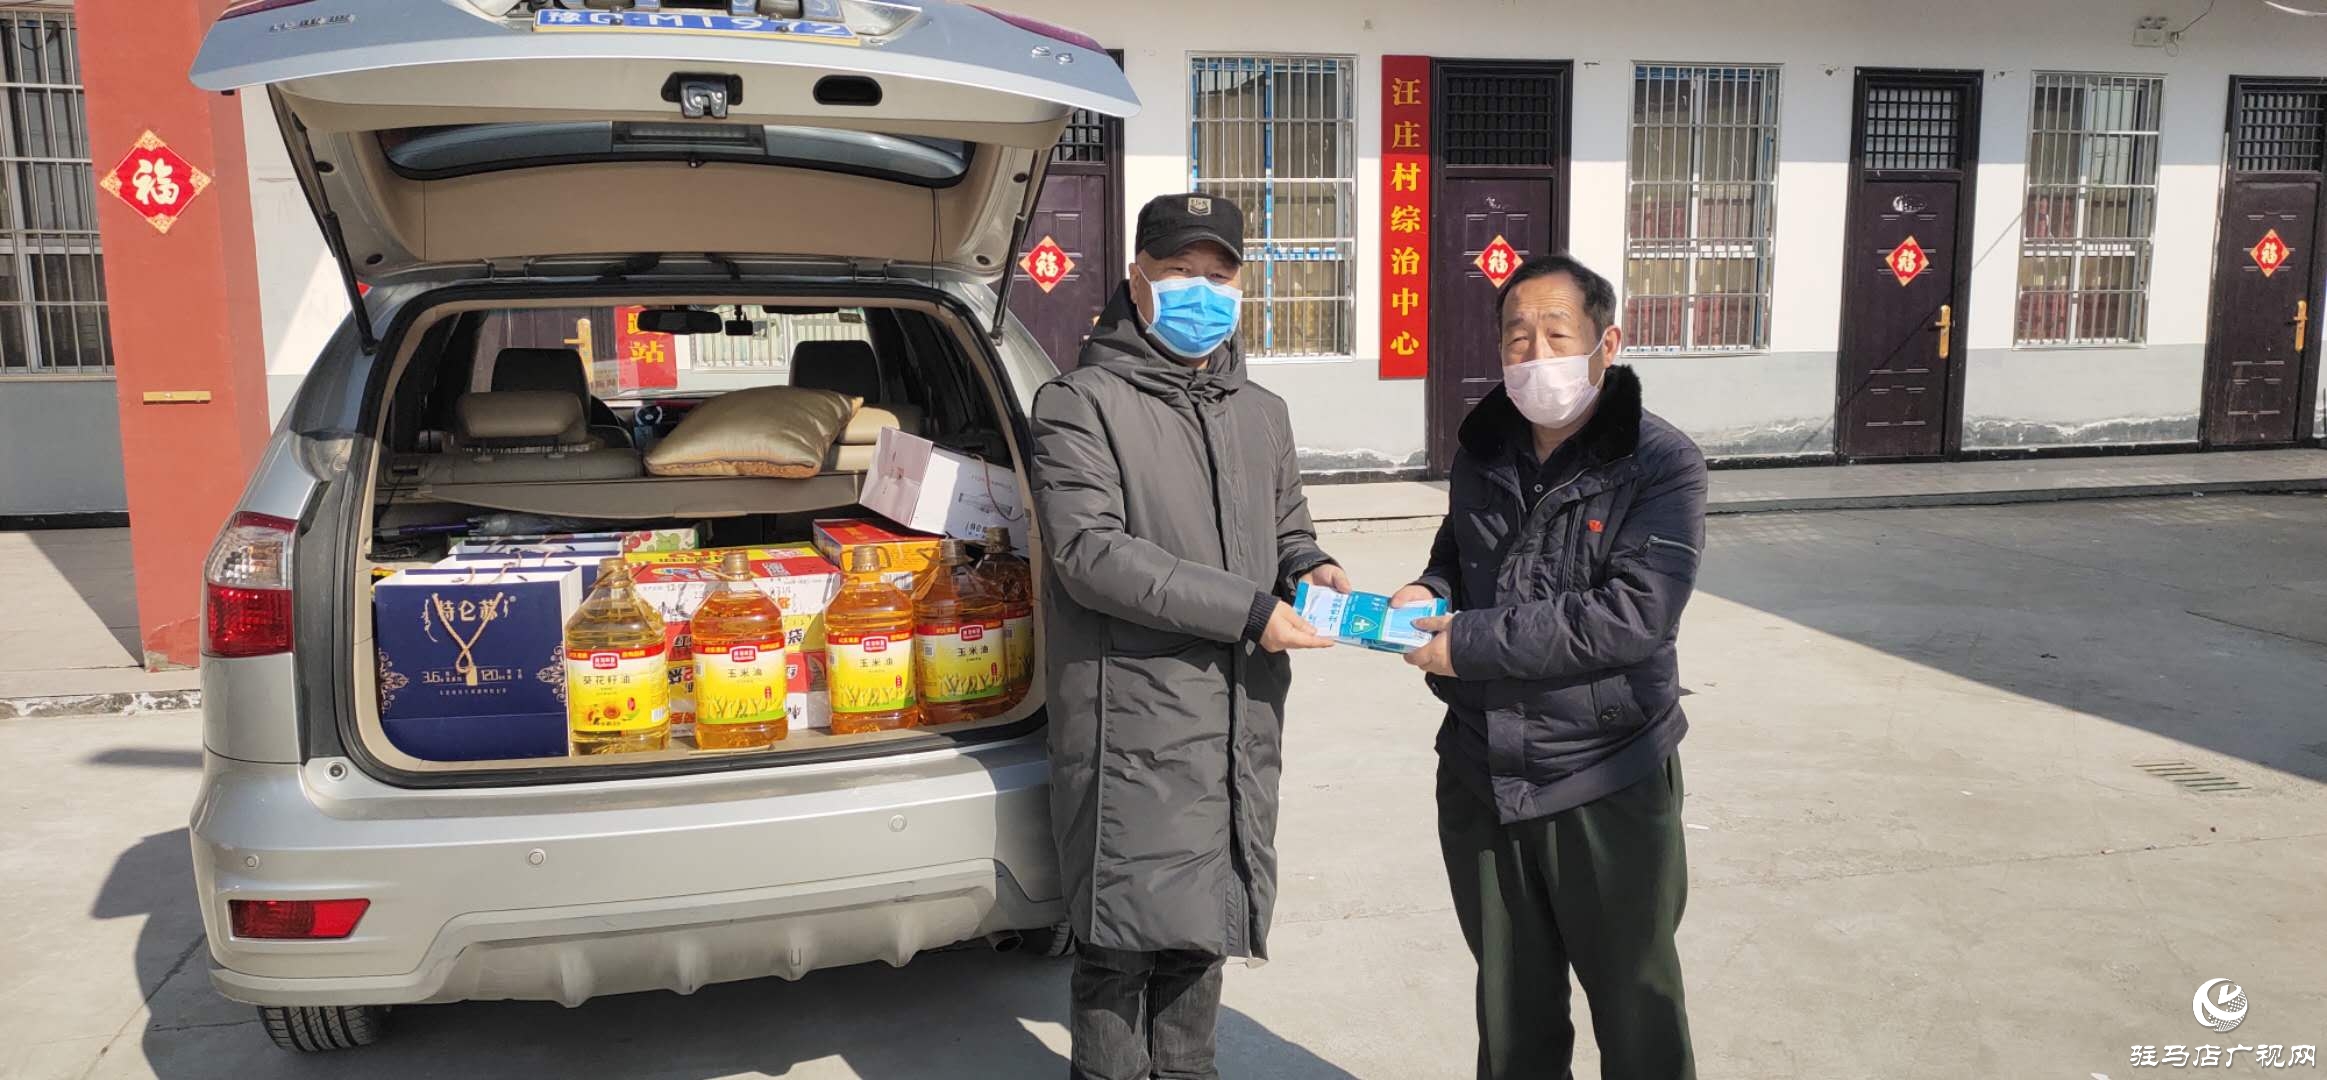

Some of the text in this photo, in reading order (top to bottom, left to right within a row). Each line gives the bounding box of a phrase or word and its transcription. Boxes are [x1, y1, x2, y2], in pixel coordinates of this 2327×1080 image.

[132, 157, 180, 206] 福
[1390, 77, 1421, 356] 汪庄村综治中心
[1035, 251, 1059, 278] 福
[1488, 249, 1509, 274] 福
[1898, 248, 1917, 273] 福
[2261, 242, 2279, 264] 福
[957, 644, 990, 657] 玉米油
[727, 666, 764, 679] 玉米油
